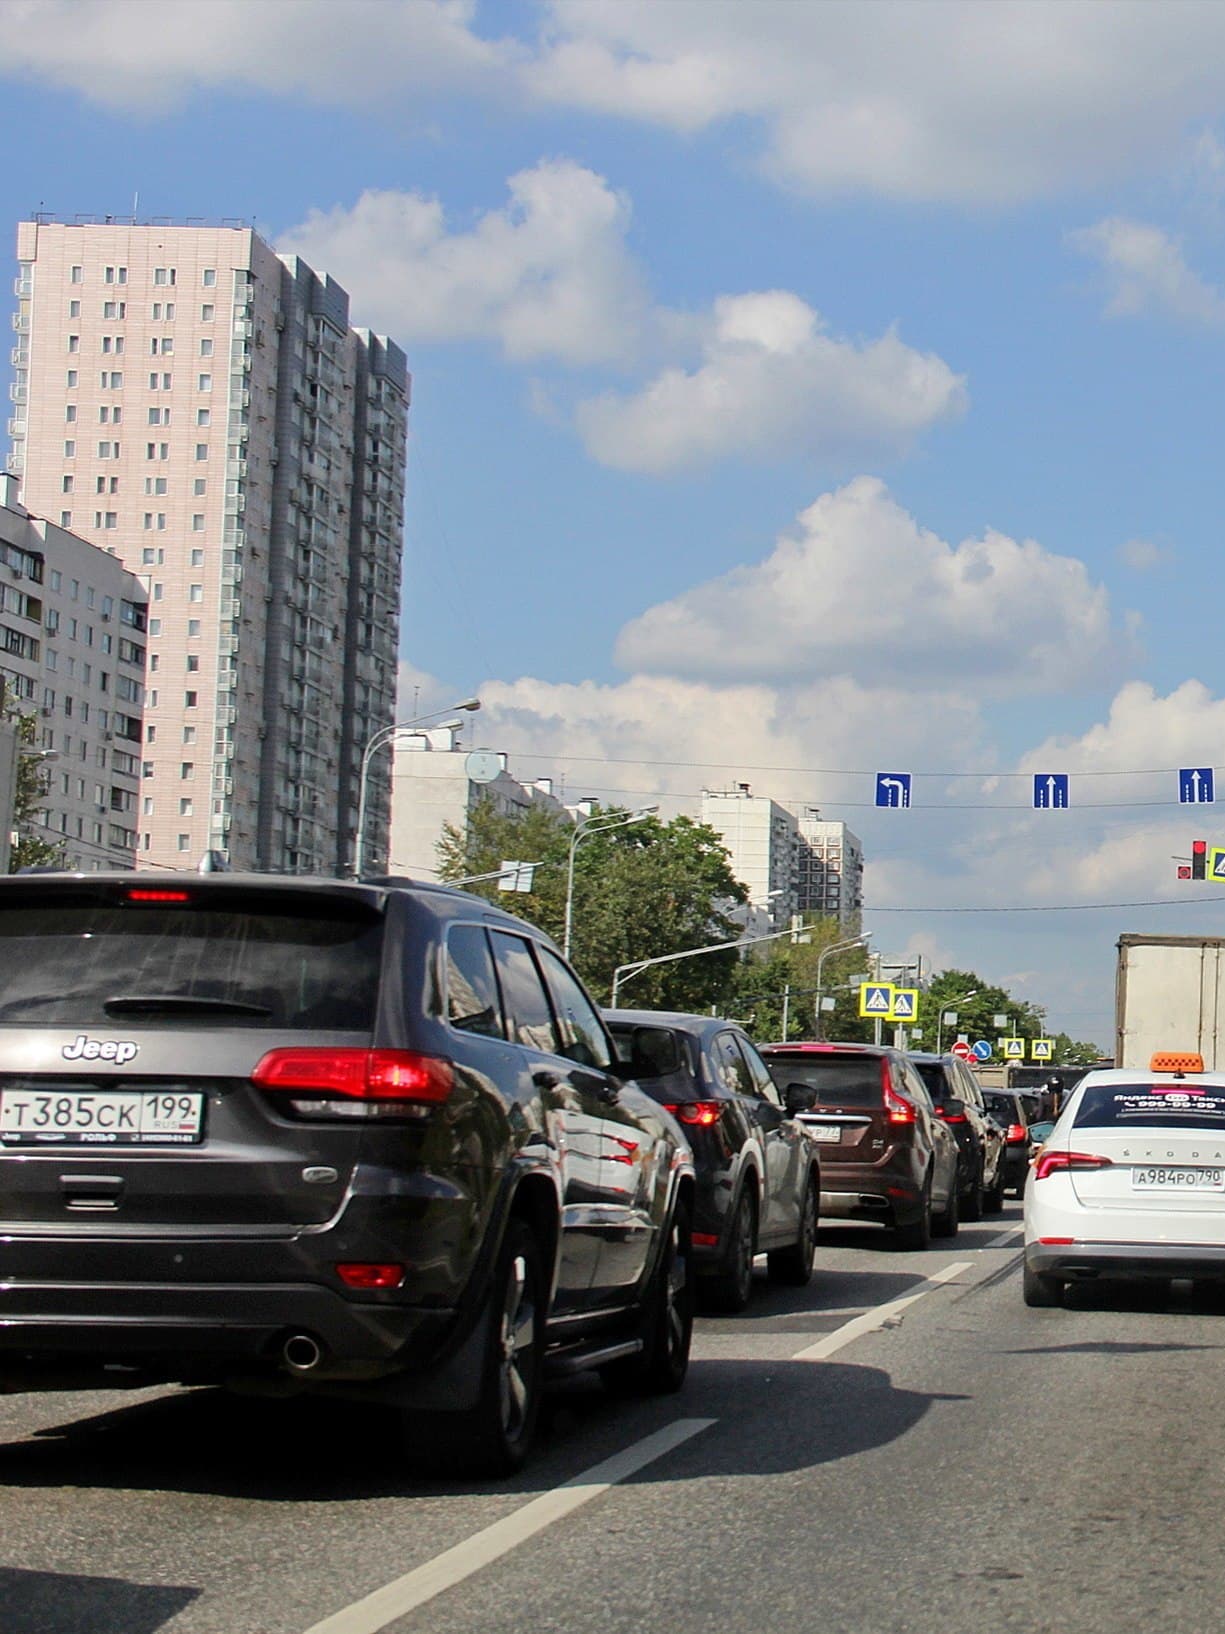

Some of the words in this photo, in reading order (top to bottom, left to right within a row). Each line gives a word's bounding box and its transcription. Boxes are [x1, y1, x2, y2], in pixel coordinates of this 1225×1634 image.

[62, 1035, 138, 1065] Jeep
[13, 1097, 137, 1128] Т385СК
[146, 1095, 193, 1120] 199
[154, 1120, 178, 1130] RUS
[1137, 1168, 1196, 1186] А984РО
[1197, 1169, 1221, 1182] 790
